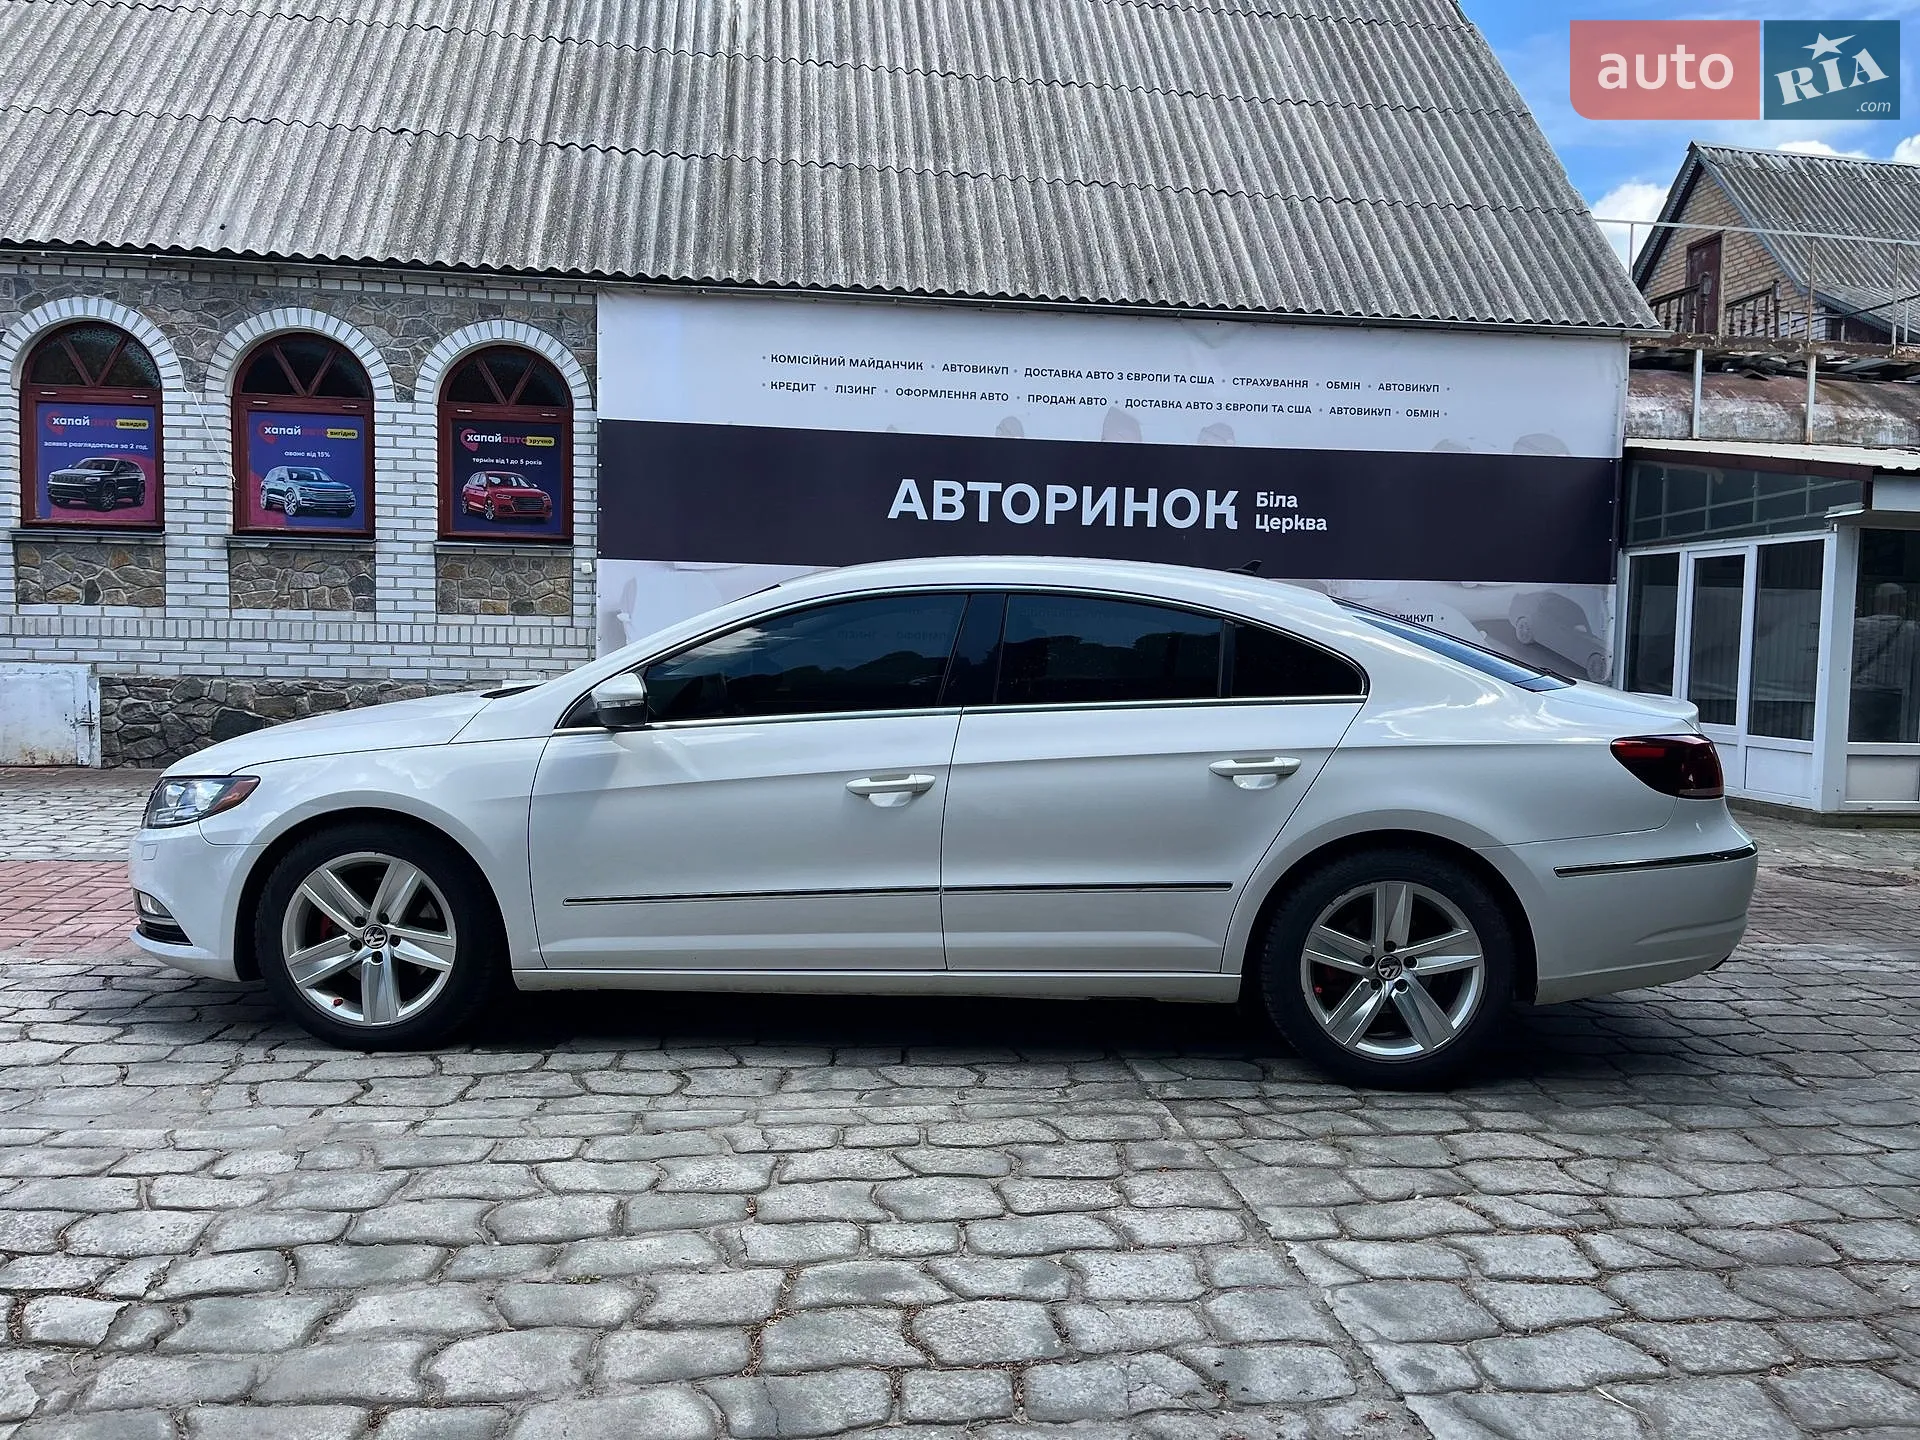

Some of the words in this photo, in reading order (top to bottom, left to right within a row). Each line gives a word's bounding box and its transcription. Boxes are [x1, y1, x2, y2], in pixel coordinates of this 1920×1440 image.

[770, 352, 846, 368] КОМІСІЙНИЙ
[848, 356, 924, 372] МАЙДАНЧИК
[941, 362, 1009, 376] АВТОВИКУП
[1023, 366, 1083, 380] ДОСТАВКА
[1085, 370, 1114, 381] АВТО
[1116, 371, 1124, 381] З
[1126, 371, 1171, 384] ЄВРОПИ
[1172, 373, 1188, 384] ТА
[1189, 374, 1215, 386] США
[1232, 376, 1309, 390] СТРАХУВАННЯ
[770, 380, 817, 394] КРЕДИТ
[834, 383, 878, 396] ЛІЗИНГ
[1325, 380, 1361, 392] ОБМІН
[1377, 382, 1440, 394] АВТОВИКУП
[895, 387, 977, 401] ОФОРМЛЕННЯ
[979, 391, 1009, 402] АВТО
[1027, 393, 1076, 406] ПРОДАЖ
[1078, 395, 1108, 407] АВТО
[1125, 398, 1183, 411] ДОСТАВКА
[1185, 400, 1213, 411] АВТО
[1216, 401, 1223, 412] З
[1225, 402, 1269, 414] ЄВРОПИ
[1271, 404, 1285, 414] ТА
[1287, 404, 1312, 416] США
[1328, 406, 1392, 419] АВТОВИКУП
[1405, 409, 1440, 420] ОБМІН
[887, 478, 1239, 530] АВТОРИНОК
[1255, 491, 1299, 509] Біла
[1255, 513, 1328, 534] Церква
